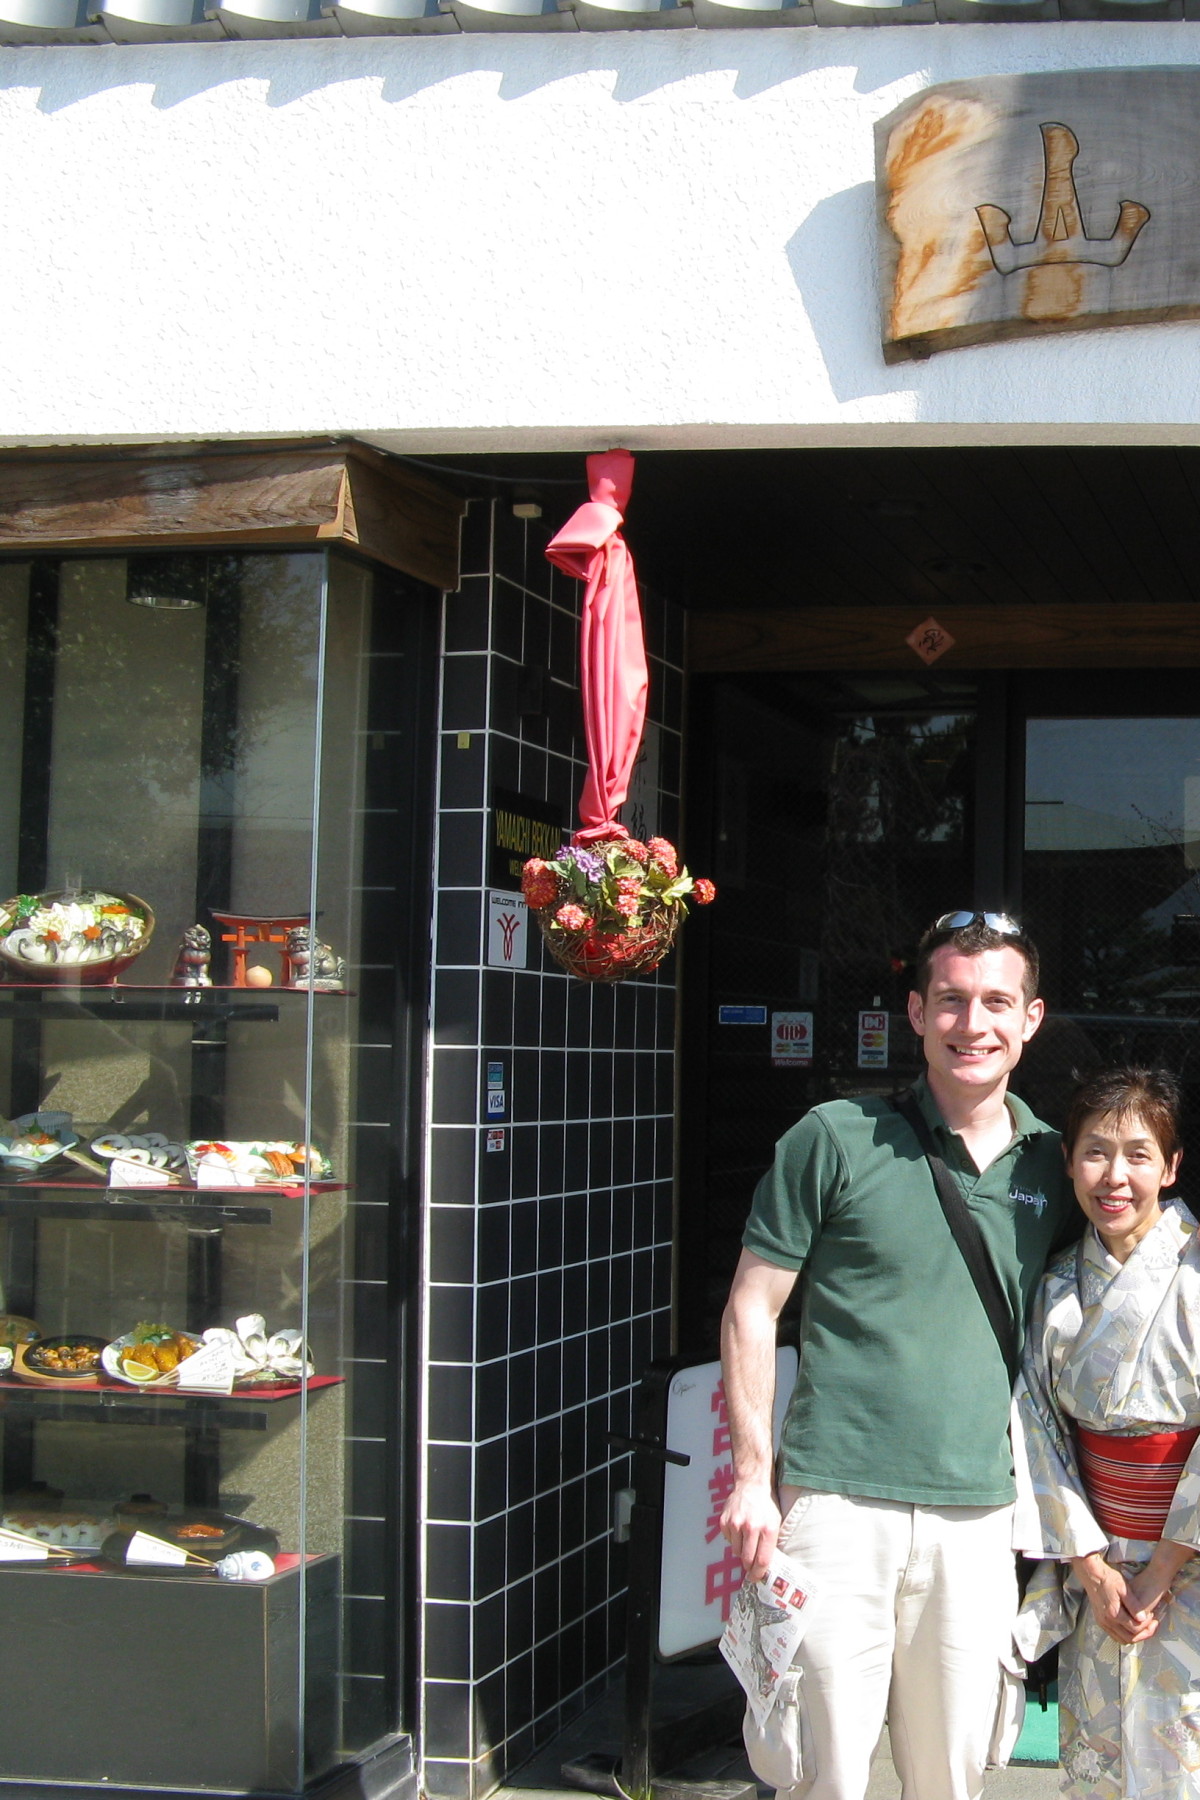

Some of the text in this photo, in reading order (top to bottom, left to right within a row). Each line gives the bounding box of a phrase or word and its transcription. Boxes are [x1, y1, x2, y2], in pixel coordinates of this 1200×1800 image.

[496, 809, 561, 861] YAMAICHI BEKKAN
[491, 896, 517, 908] WELCOME
[774, 1058, 809, 1067] Welcome
[489, 1095, 504, 1108] VISA
[1009, 1189, 1048, 1209] Japan
